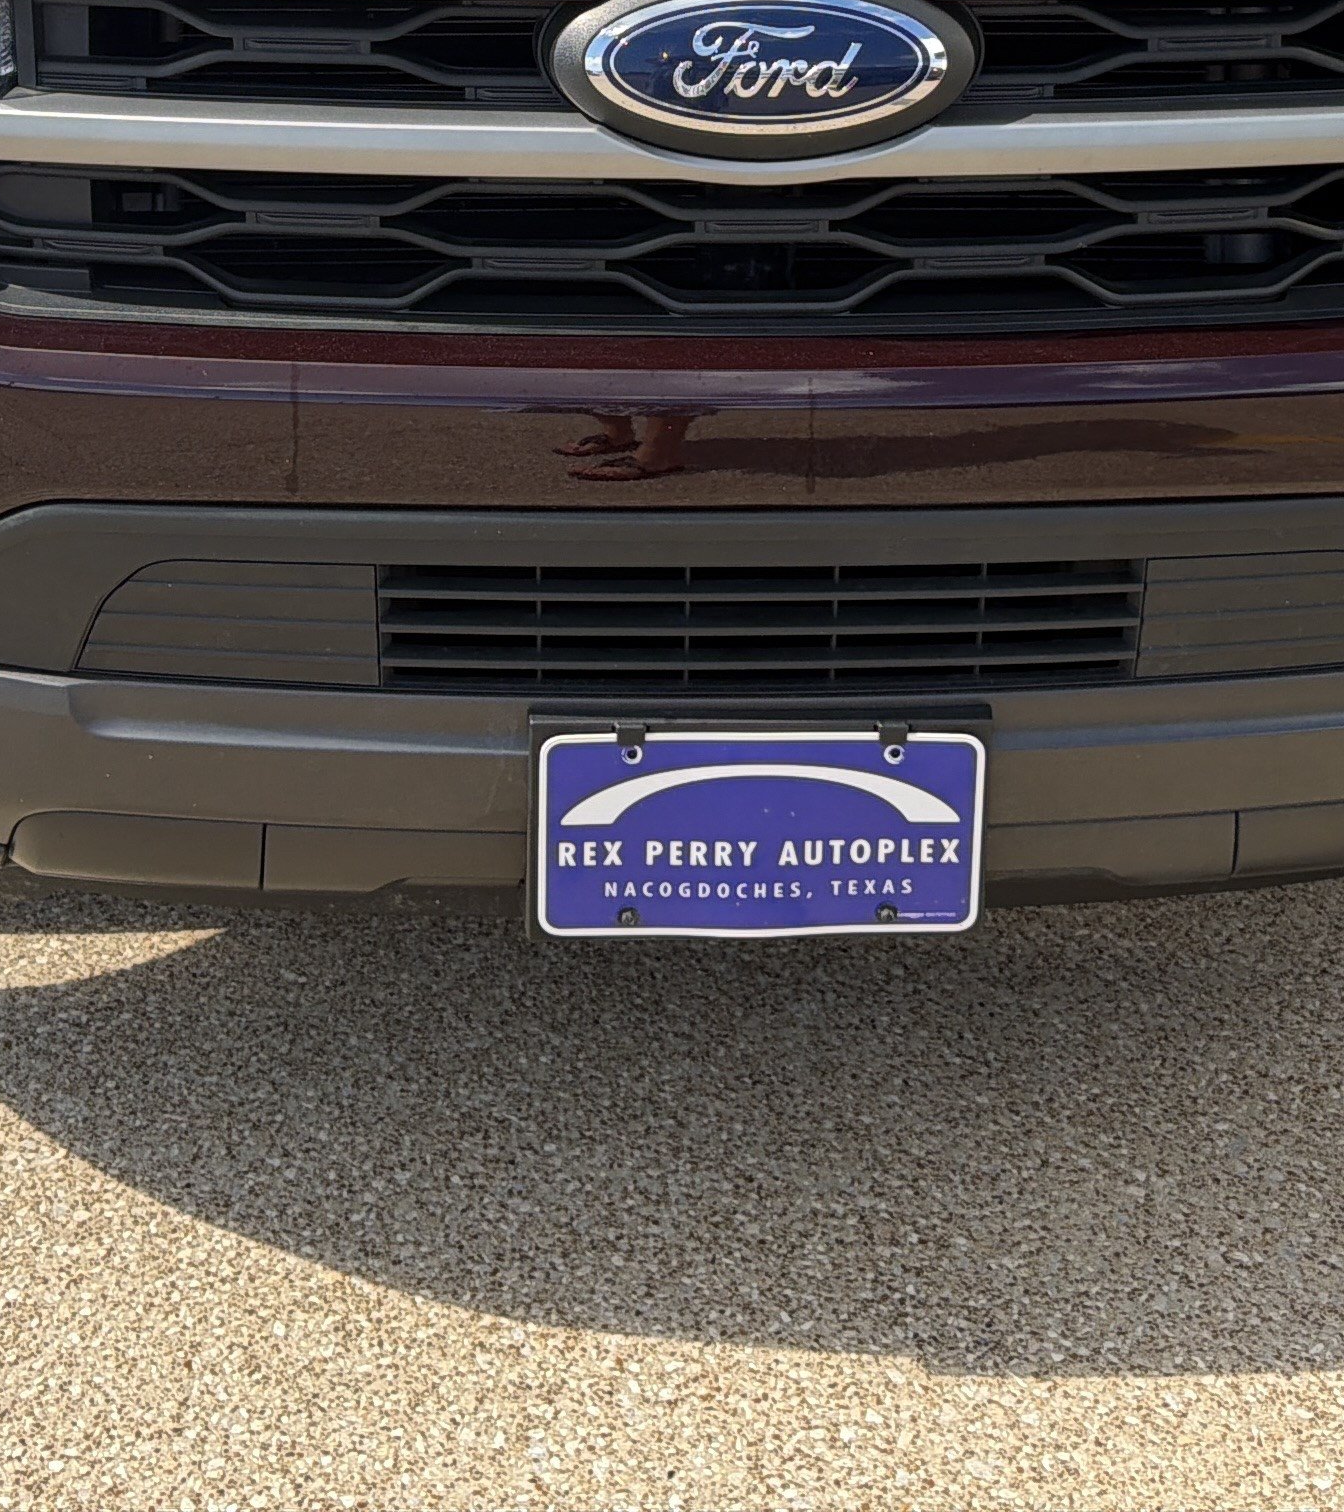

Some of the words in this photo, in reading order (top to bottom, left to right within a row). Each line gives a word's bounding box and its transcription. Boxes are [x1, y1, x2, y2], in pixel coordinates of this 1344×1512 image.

[673, 21, 860, 99] Ford
[558, 840, 623, 868] REX
[645, 841, 758, 867] PERRY
[778, 838, 960, 866] AUTOPLEX
[604, 881, 814, 900] NACOGDOCHES,
[831, 878, 914, 896] TEXAS
